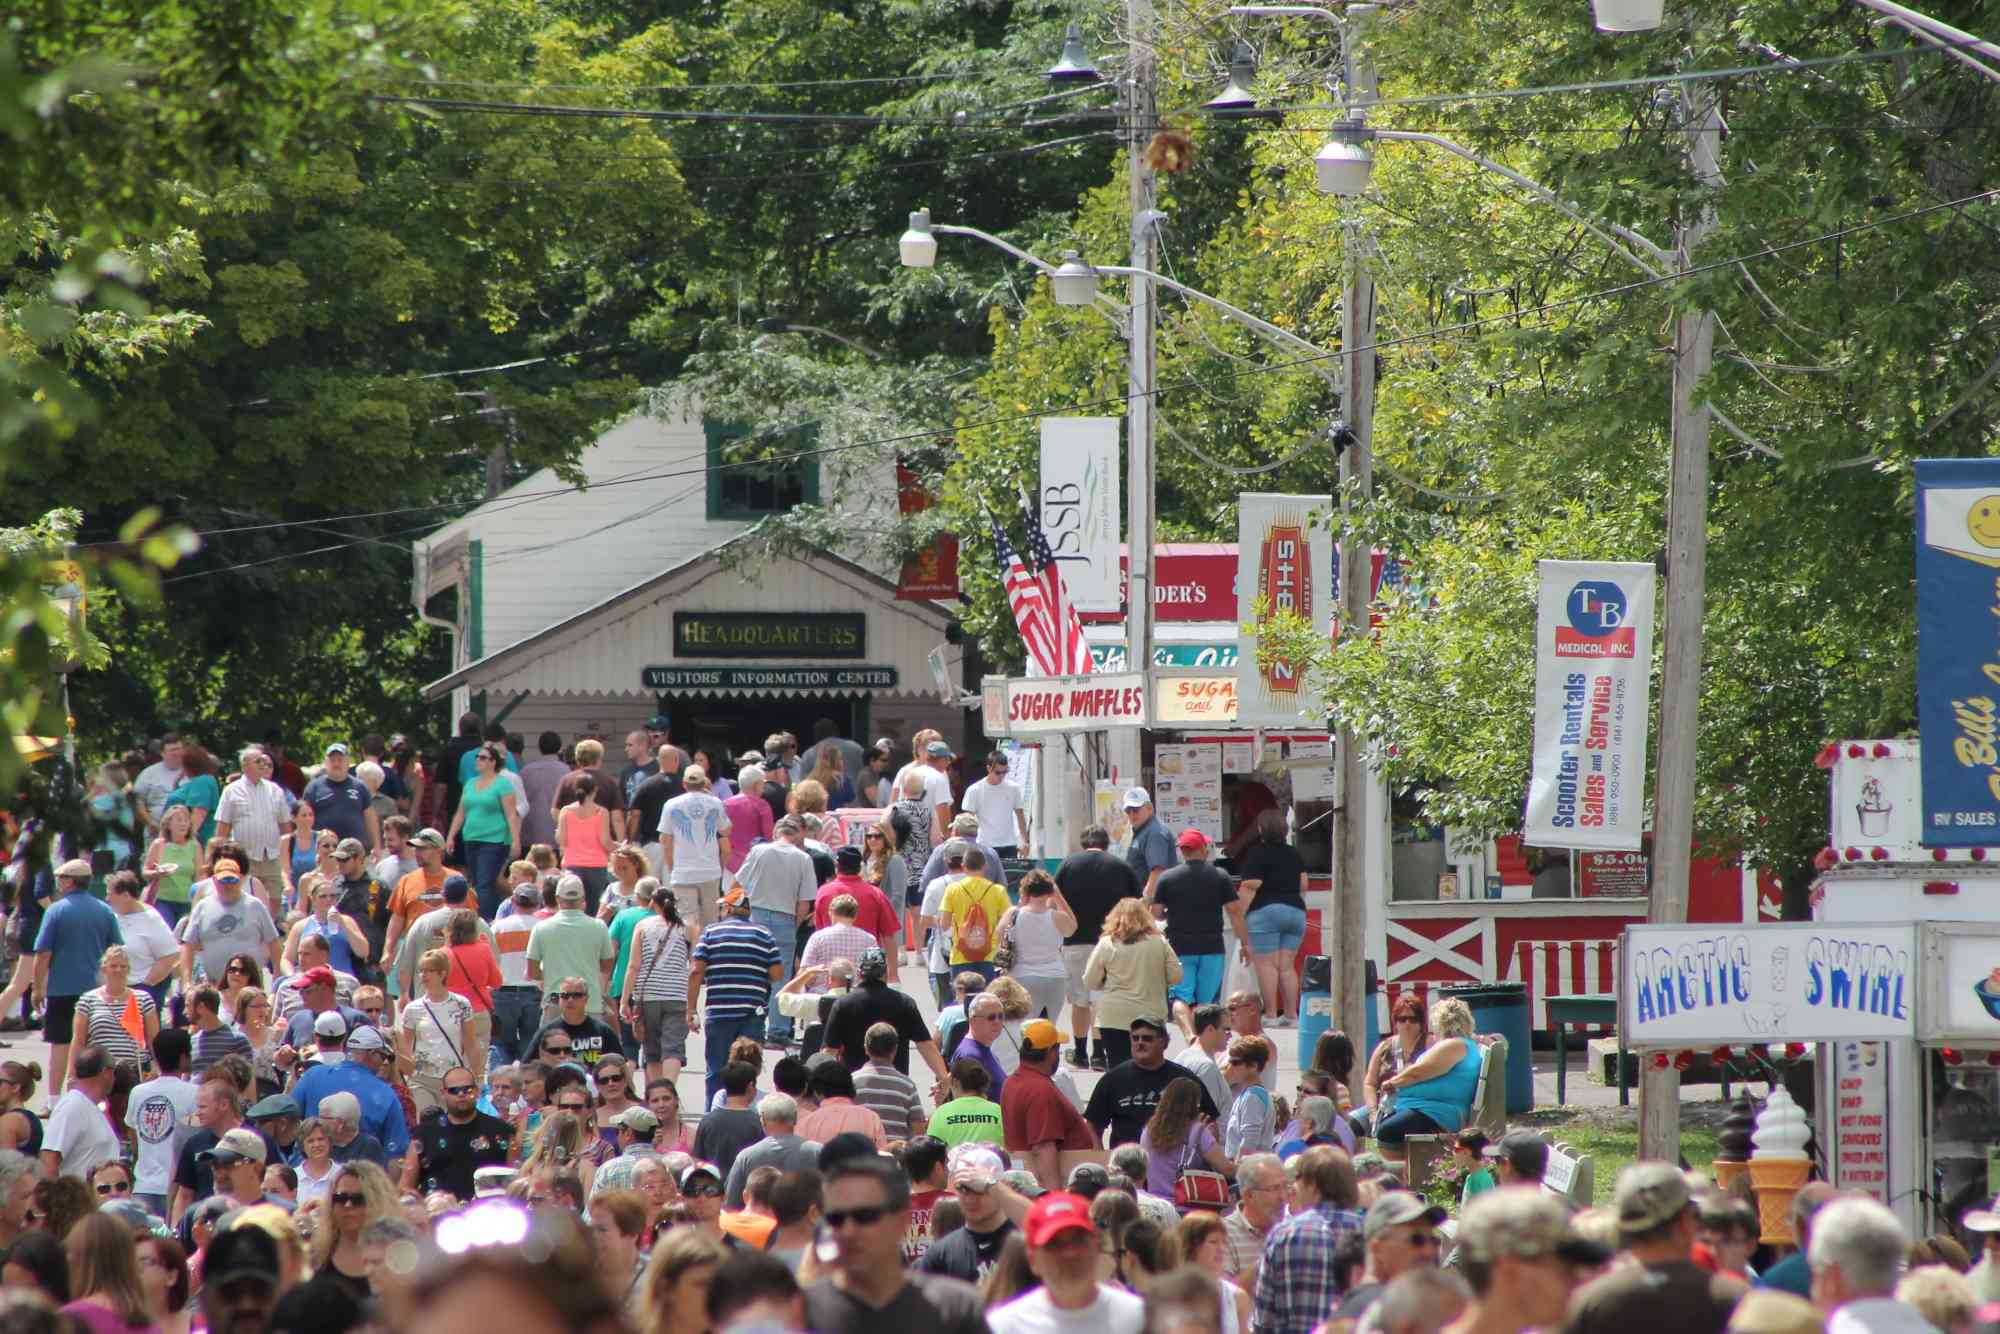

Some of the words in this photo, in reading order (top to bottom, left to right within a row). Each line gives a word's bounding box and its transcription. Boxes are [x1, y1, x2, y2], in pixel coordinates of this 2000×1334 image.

[1275, 540, 1295, 680] SHEZ
[683, 620, 857, 646] HEADQUARTERS
[1610, 642, 1633, 655] INC.
[732, 671, 829, 684] INFORMATION
[836, 671, 891, 684] CENTER
[1177, 681, 1236, 696] SUGA
[1008, 692, 1064, 721] SUGAR
[1068, 686, 1143, 717] WAFFLES
[1559, 672, 1586, 746] Rentals
[1585, 675, 1613, 750] Service
[1951, 695, 1998, 767] Bill's
[1591, 754, 1602, 772] and
[1552, 751, 1580, 828] Scooter
[1579, 774, 1606, 827] Sales
[1933, 812, 1951, 826] RV
[1954, 811, 1997, 826] SALES
[1634, 935, 1751, 1024] ARCTIC
[1804, 937, 1909, 1020] SWIRL
[946, 1114, 999, 1125] SECURITY
